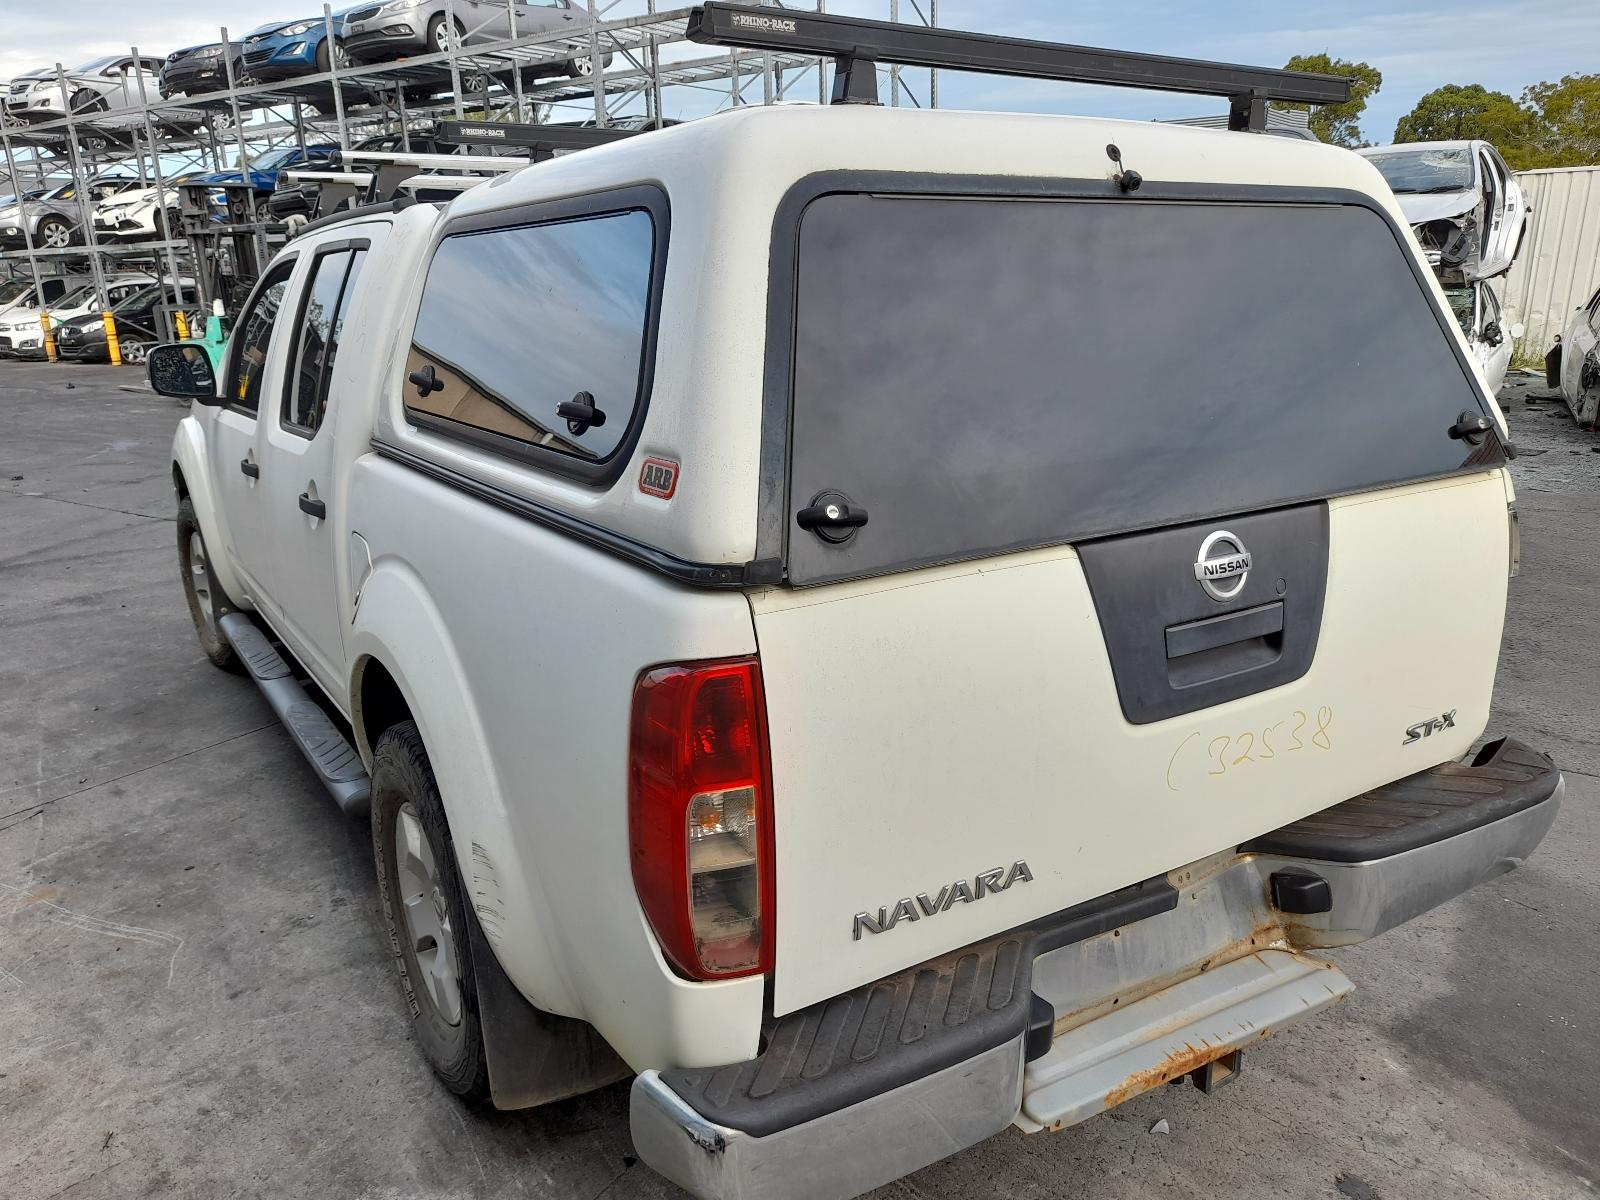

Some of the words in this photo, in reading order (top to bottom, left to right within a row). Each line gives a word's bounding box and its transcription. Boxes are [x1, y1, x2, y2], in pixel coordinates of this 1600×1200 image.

[739, 15, 796, 31] RHINO-RACK
[464, 127, 505, 137] RHINO-RACK
[642, 464, 673, 491] ARB
[1203, 557, 1249, 576] NISSAN
[1402, 709, 1457, 745] ST-X
[853, 859, 1034, 941] NAVARA
